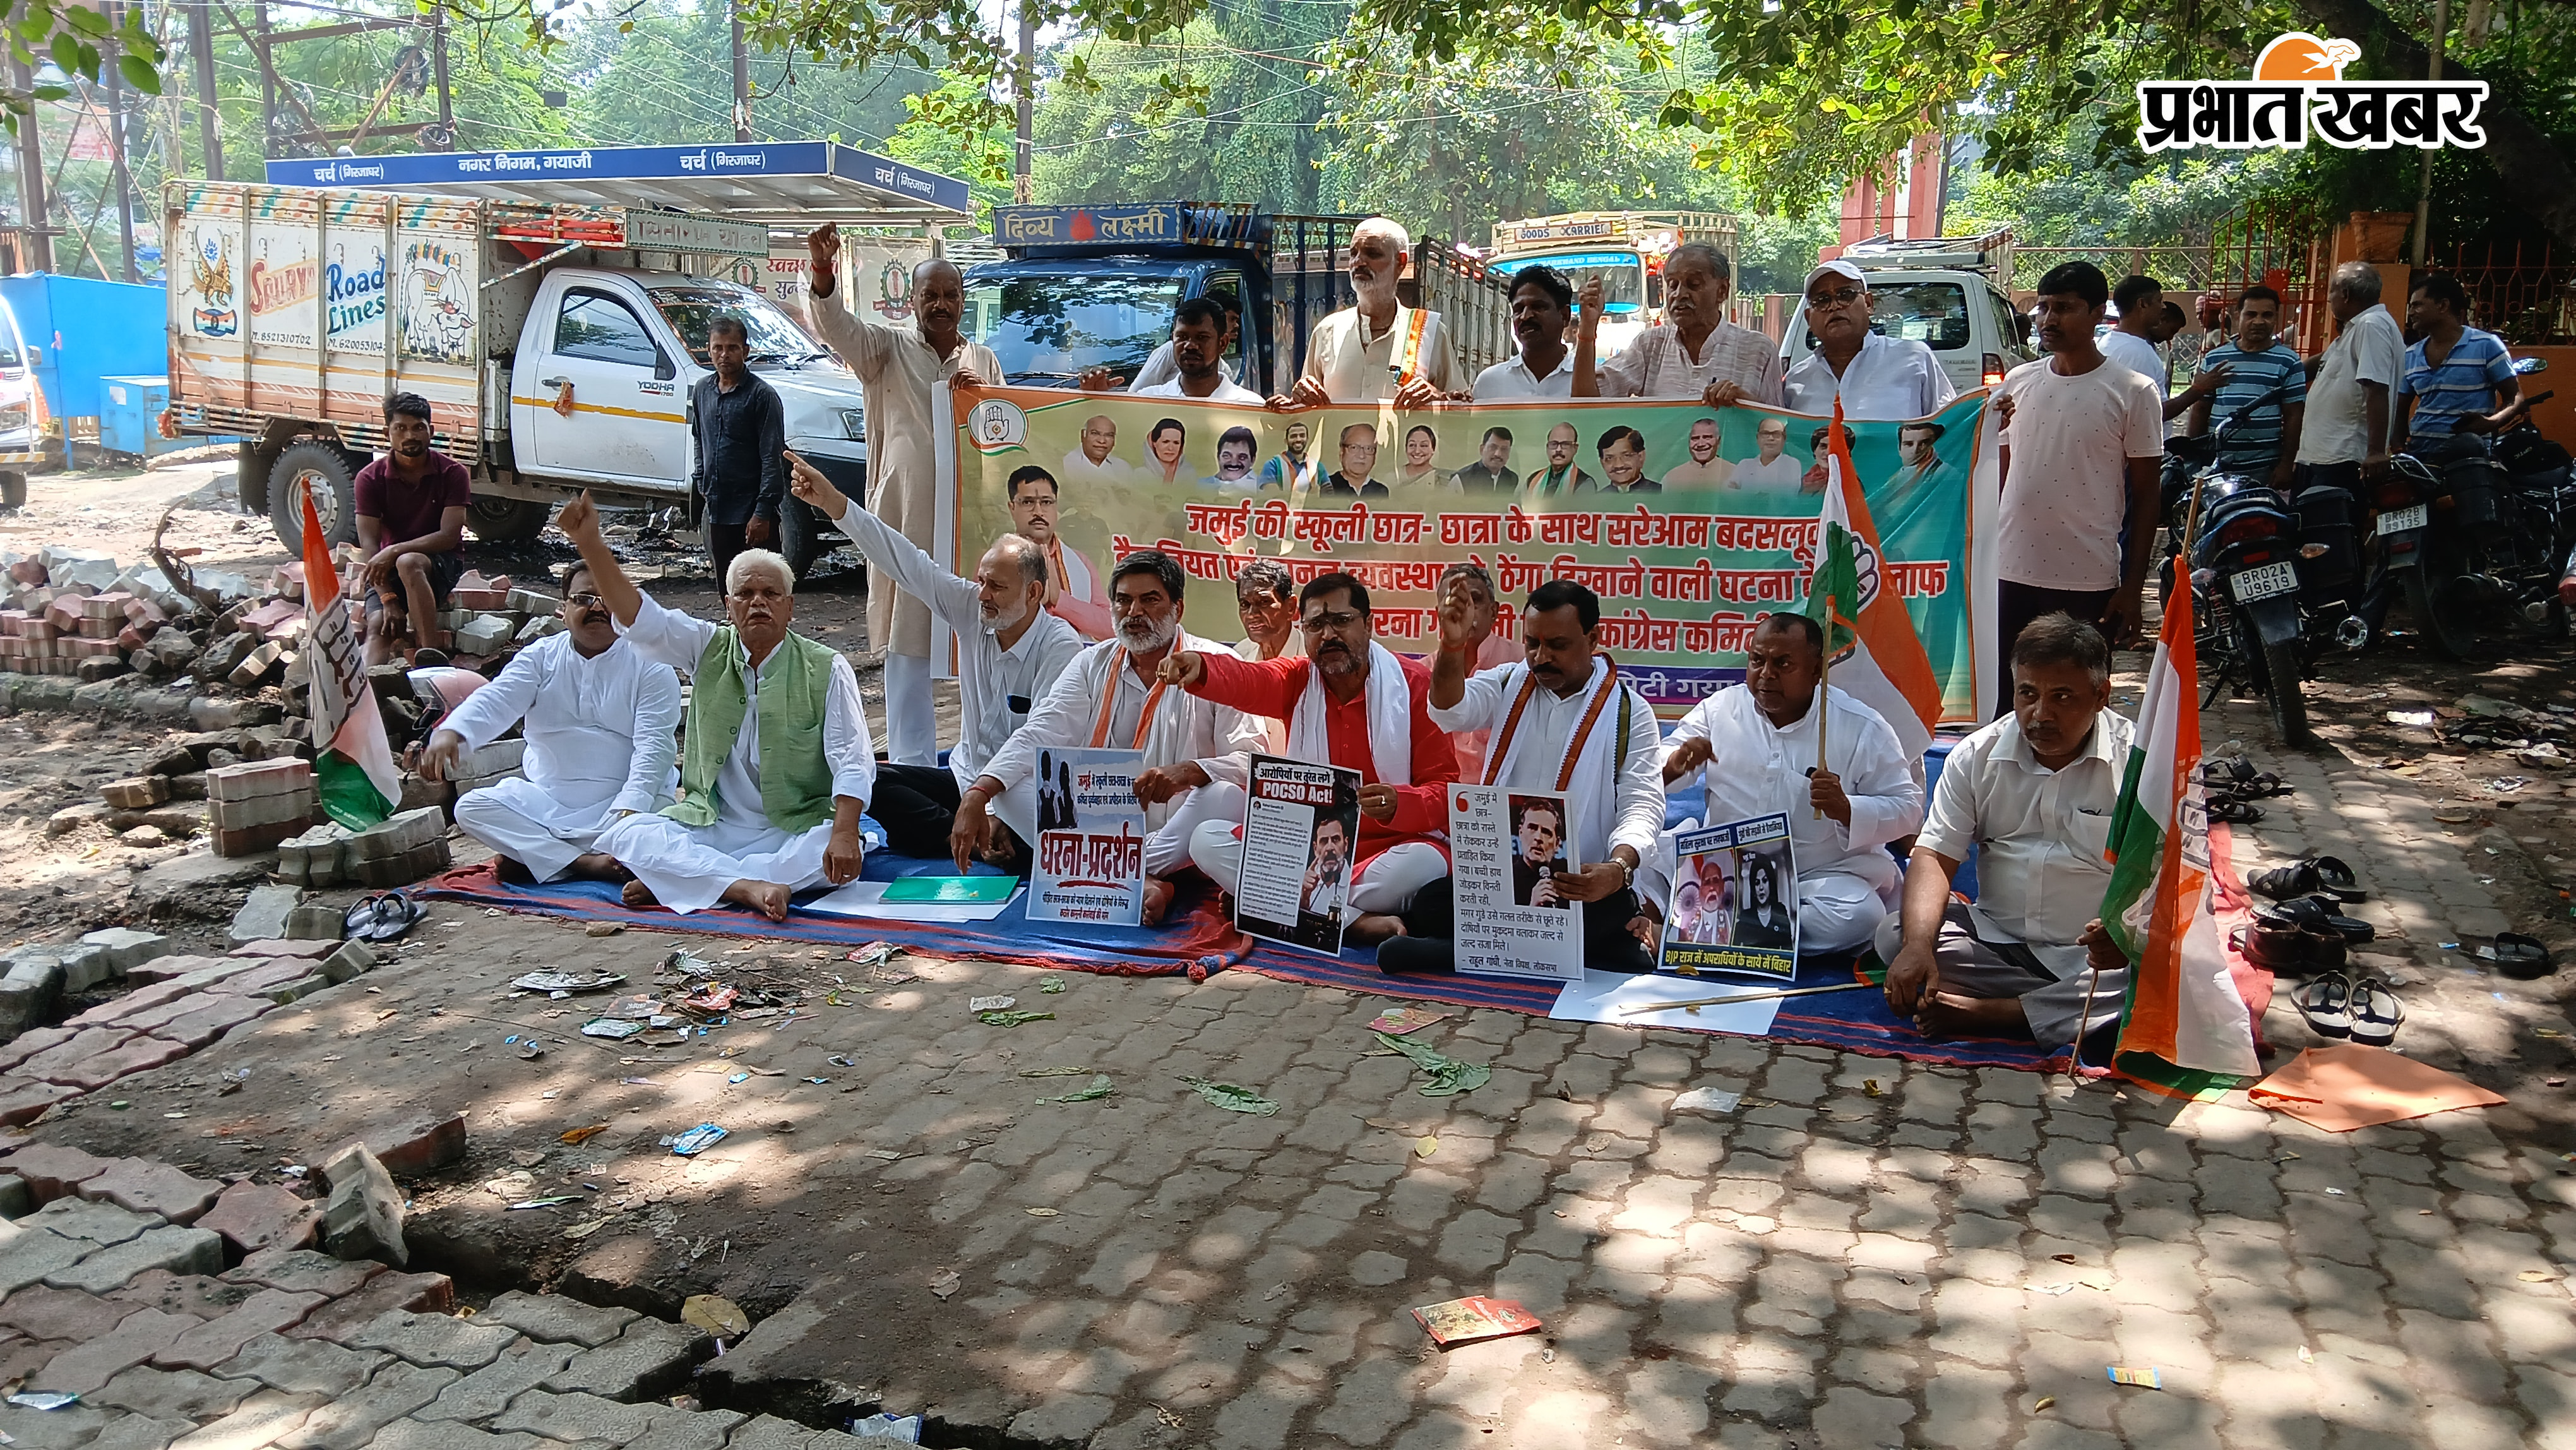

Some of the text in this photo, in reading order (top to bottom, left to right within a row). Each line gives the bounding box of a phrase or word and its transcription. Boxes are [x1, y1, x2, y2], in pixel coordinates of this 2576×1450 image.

[458, 158, 490, 172] नगर
[543, 151, 592, 169] गयाजी
[679, 149, 707, 171] चर्च
[314, 162, 336, 181] चर्च
[875, 166, 896, 186] चर्च
[1003, 210, 1170, 241] दिव्य लक्ष्मी
[1520, 228, 1550, 239] GOODS
[326, 254, 386, 303] Road
[326, 295, 386, 336] Lines
[637, 381, 675, 391] YODHA
[2385, 506, 2419, 523] BR02B
[1185, 500, 1251, 546] जमुई
[1254, 500, 1289, 539] की
[1294, 503, 1369, 551] स्कूली
[1440, 514, 1501, 544] छात्रा
[1505, 505, 1534, 544] के
[1539, 513, 1602, 544] साथ
[1606, 505, 1711, 548] सरेआम
[1714, 517, 1820, 562] बदसलू
[1649, 560, 1712, 601] वाली
[1717, 569, 1794, 602] घटना
[2242, 564, 2288, 584] BR02A
[2244, 576, 2290, 596] U9619
[1371, 608, 1424, 638] रना
[1599, 608, 1679, 652] कांग्रेस
[1683, 612, 1770, 653] कमि
[1617, 671, 1670, 697] मिटी
[1078, 770, 1091, 791] जमुई
[1259, 766, 1330, 784] आरोपियों पर तुरंत लगे
[1262, 781, 1333, 803] POCSO Act!
[1474, 791, 1491, 806] जमुई
[1455, 820, 1496, 833] छात्रा को रास्ते
[1462, 834, 1486, 846] रोककर
[1479, 850, 1496, 863] किया
[1482, 879, 1501, 892] विनती
[1459, 892, 1477, 904] करती
[1460, 909, 1474, 918] मगर
[1486, 909, 1498, 920] उसे
[1516, 911, 1534, 923] तरीके
[1535, 913, 1542, 924] से
[1481, 925, 1490, 934] पर
[1491, 926, 1514, 938] मुकदमा
[1516, 928, 1539, 939] चलाकर
[1540, 930, 1555, 941] जल्द
[1556, 929, 1563, 942] से
[1460, 938, 1476, 949] जल्द
[1468, 956, 1484, 968] राहुल
[1665, 950, 1679, 965] BJP
[1679, 951, 1693, 963] राज
[1693, 949, 1704, 964] में
[1738, 952, 1746, 967] के
[1746, 953, 1762, 968] साये
[1762, 954, 1773, 970] में
